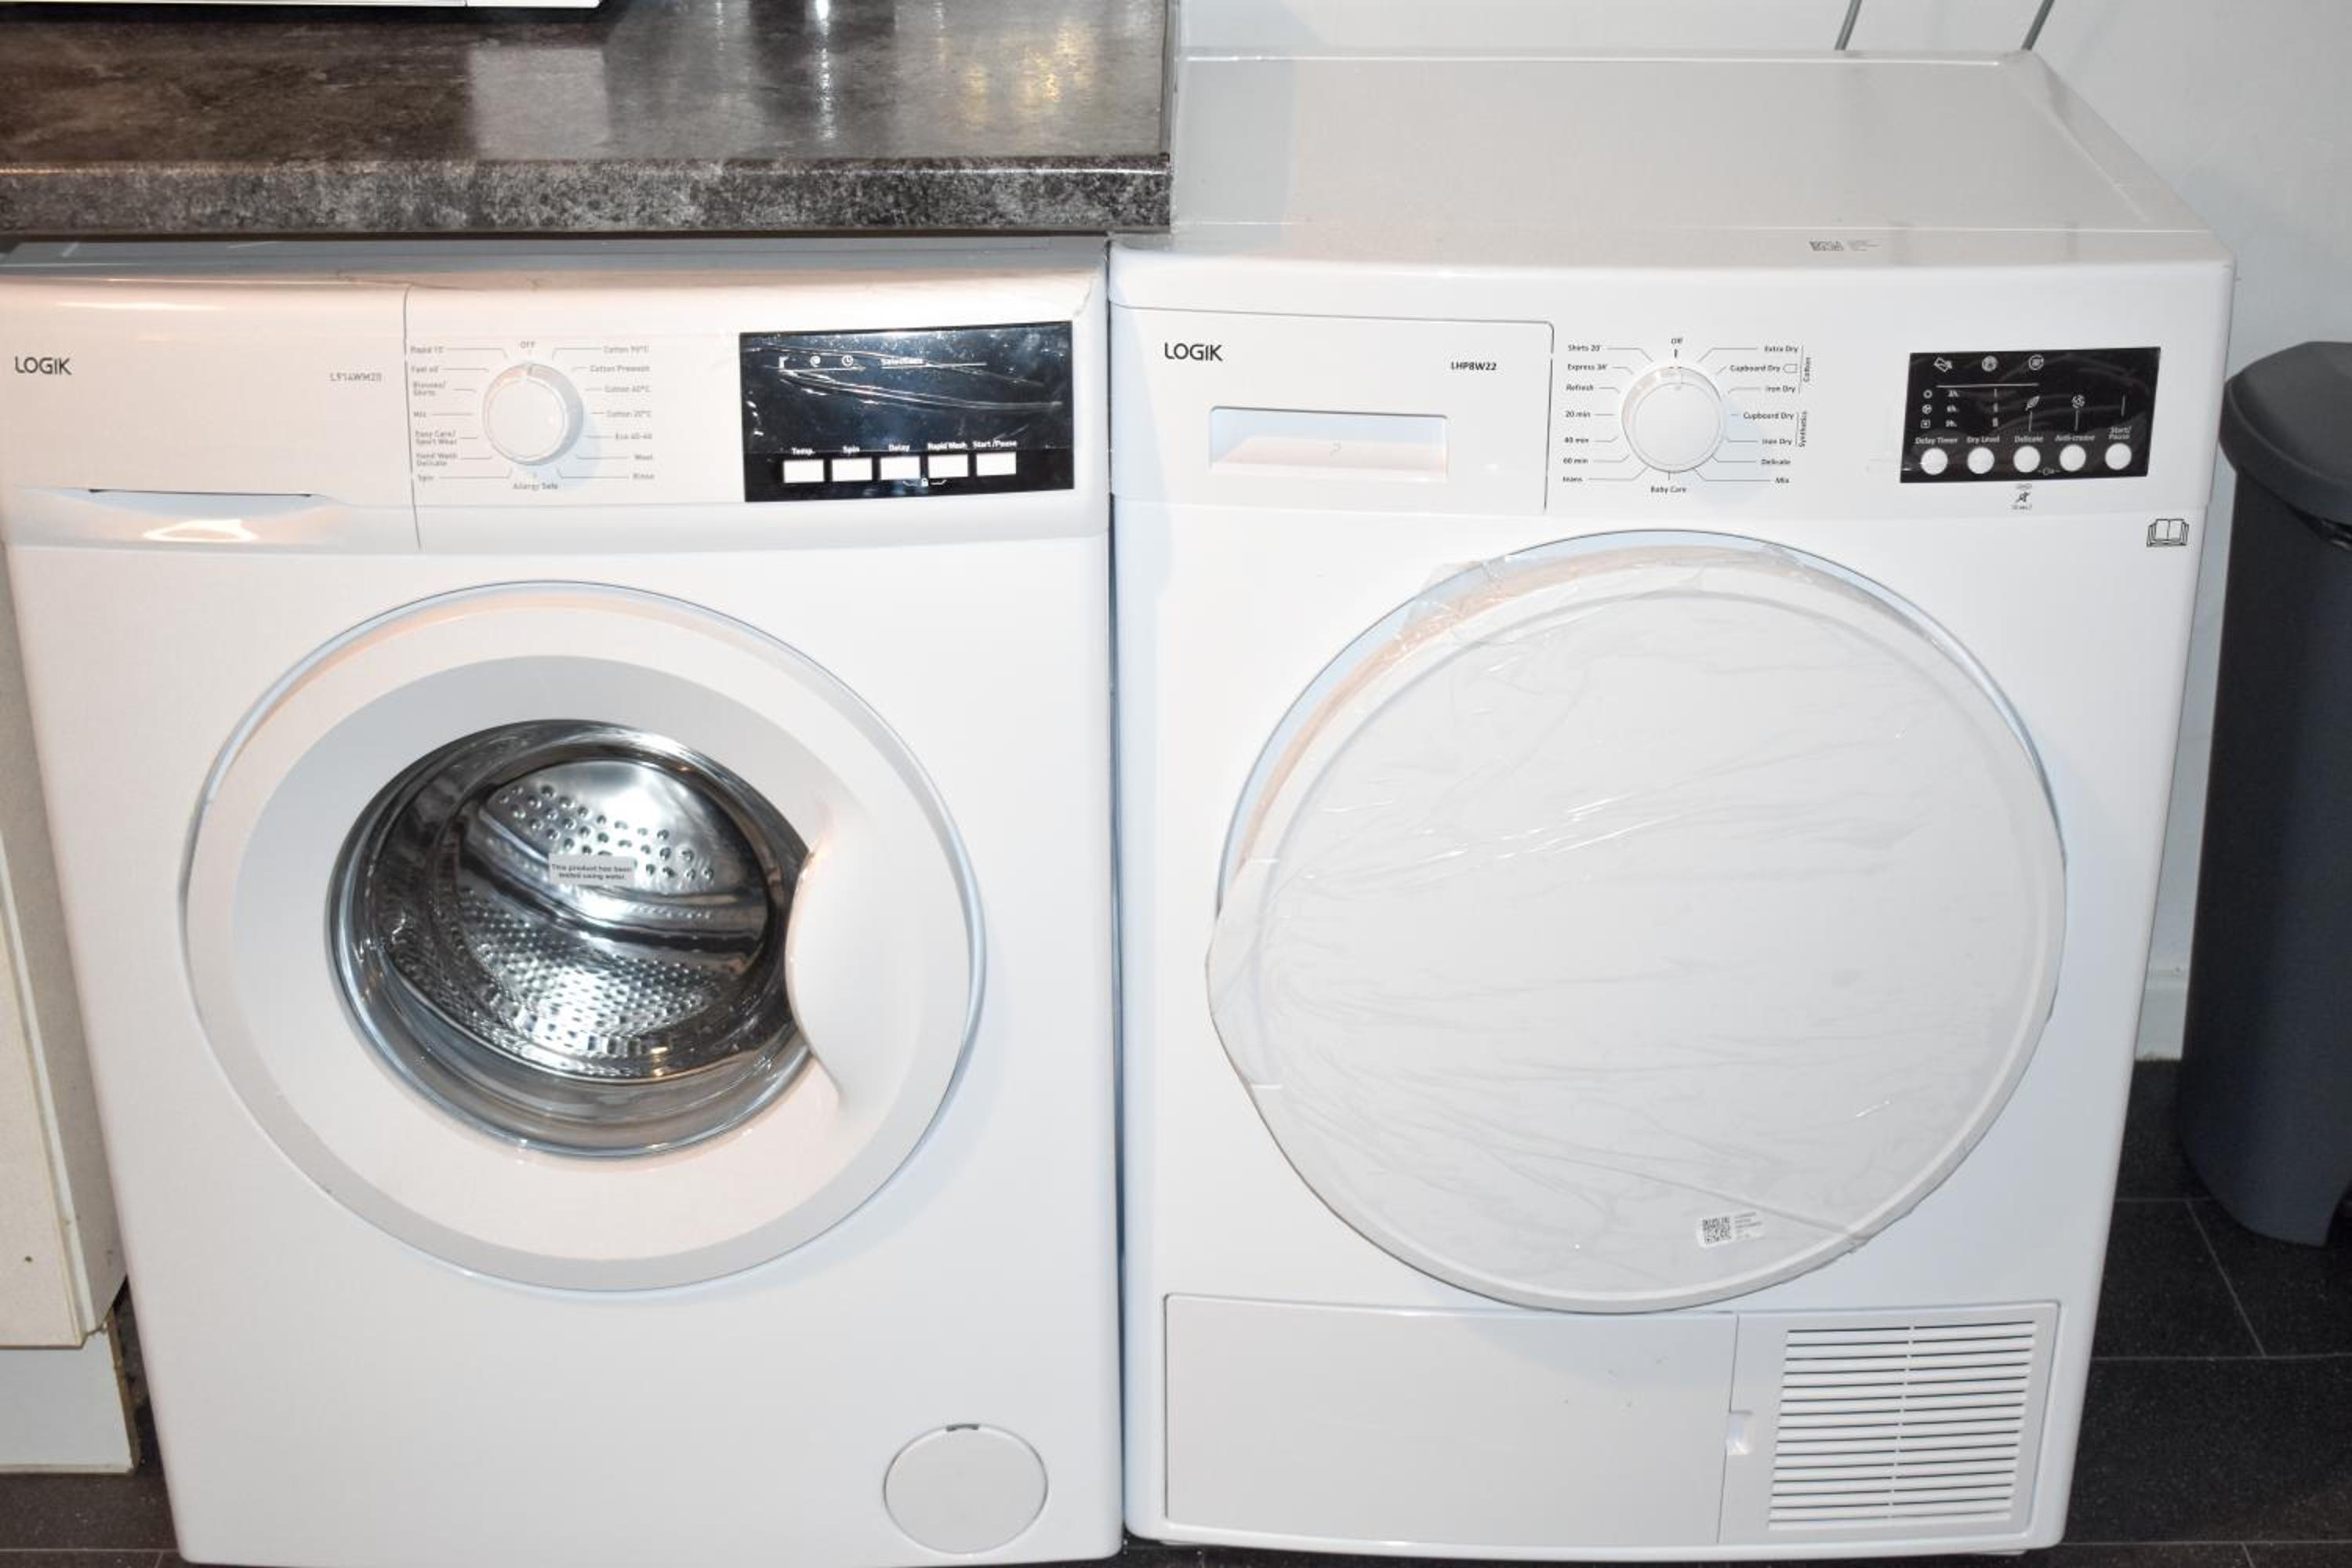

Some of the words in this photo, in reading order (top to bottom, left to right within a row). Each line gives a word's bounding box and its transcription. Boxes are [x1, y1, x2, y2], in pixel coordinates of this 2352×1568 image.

[603, 345, 629, 354] Cotton
[1164, 342, 1223, 361] LOGIK
[1785, 345, 1798, 354] Dry
[14, 356, 72, 376] LOGIK
[1451, 361, 1497, 371] LHP8W22
[1767, 365, 1781, 373] Dry
[1782, 385, 1796, 394] Dry
[1743, 412, 1779, 420] Cupboard
[1780, 412, 1794, 420] Dry
[1915, 437, 1936, 445] Delay
[1936, 436, 1958, 445] Timer
[1966, 436, 1980, 445] Dry
[1981, 435, 2000, 444] Level
[842, 445, 860, 455] Spin
[888, 443, 909, 452] Delay
[927, 442, 947, 451] Rapid
[512, 482, 539, 491] Allergy
[1650, 486, 1668, 495] Baby
